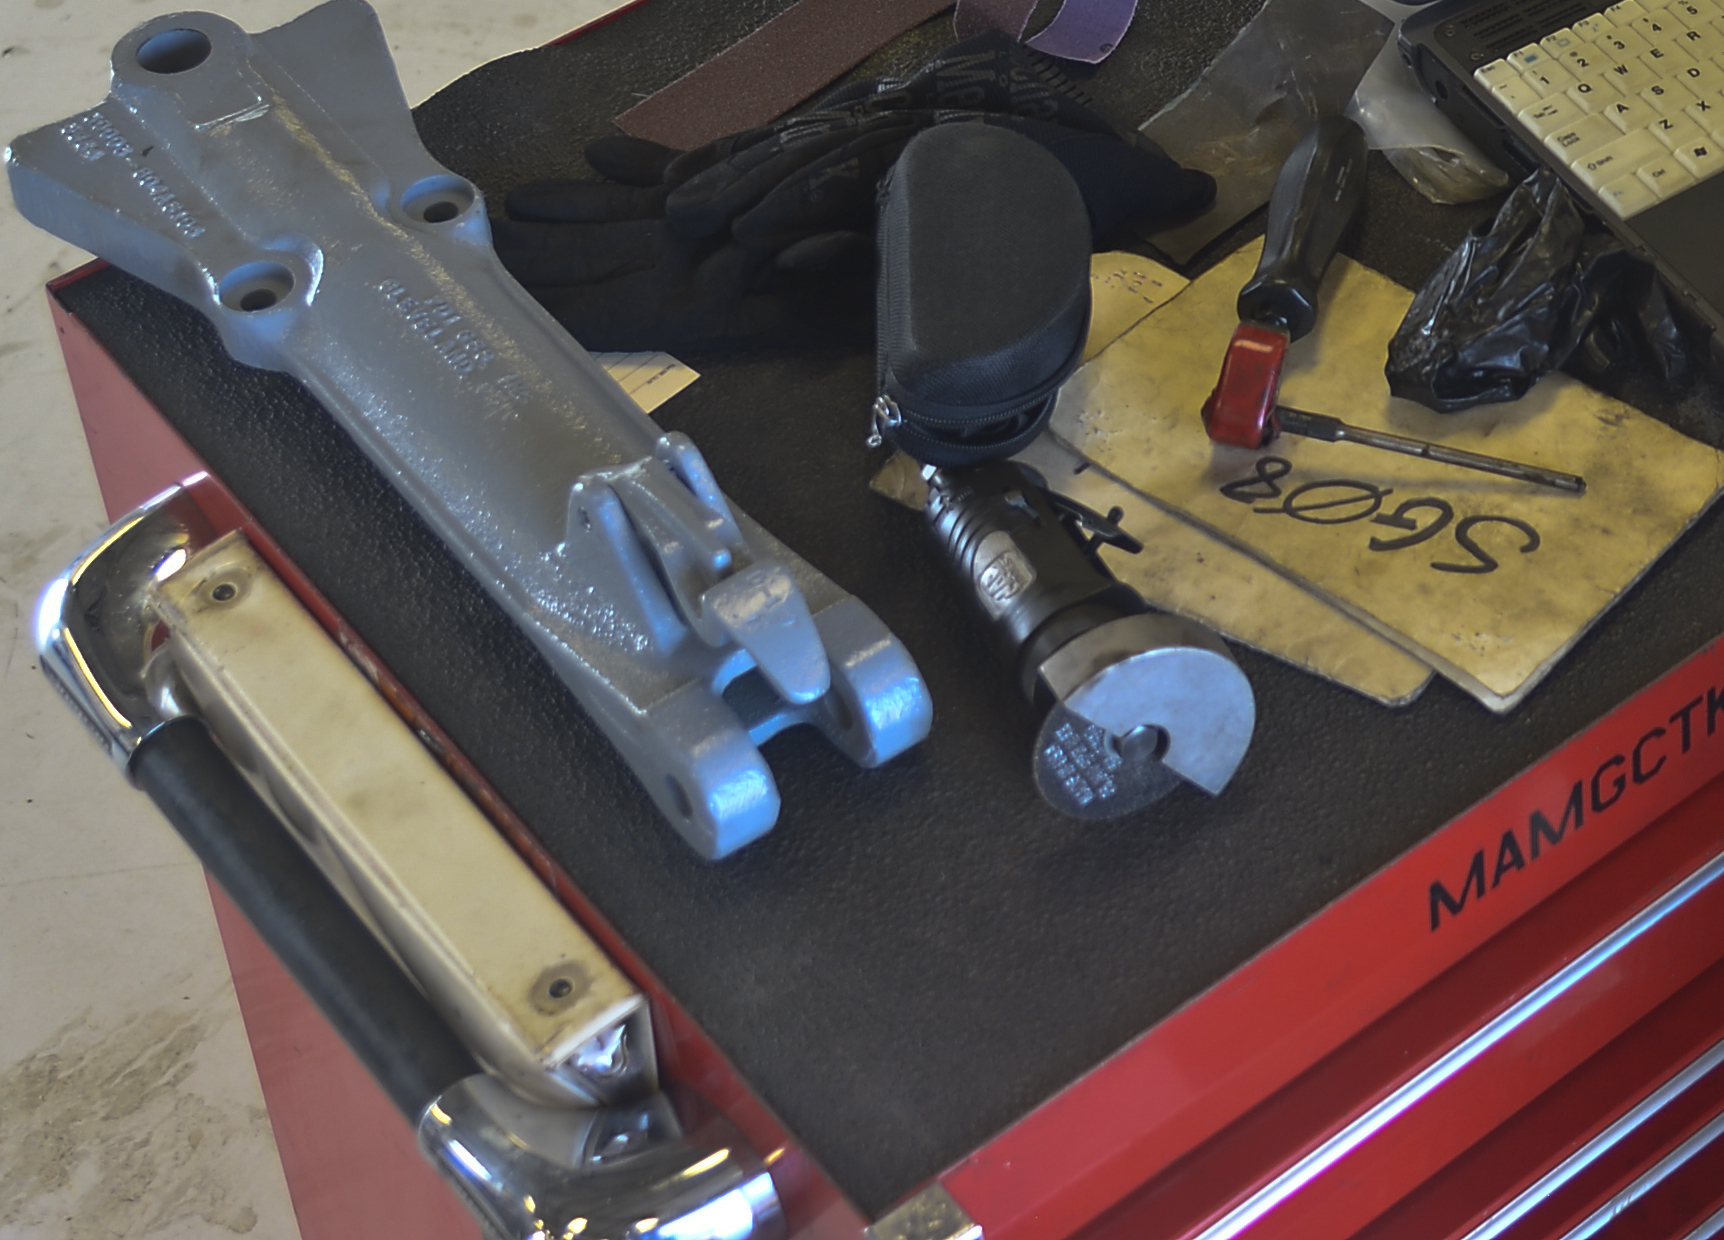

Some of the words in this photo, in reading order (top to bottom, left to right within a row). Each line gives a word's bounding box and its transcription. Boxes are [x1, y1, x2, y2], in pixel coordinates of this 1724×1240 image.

[1686, 6, 1698, 15] 5
[1652, 23, 1662, 31] 4
[1686, 31, 1701, 41] R
[1613, 41, 1625, 50] 3
[1650, 48, 1664, 58] E
[1576, 58, 1589, 68] 2
[1613, 64, 1628, 75] W
[1687, 68, 1700, 78] D
[1540, 76, 1550, 84] 1
[1577, 83, 1592, 93] Q
[1651, 85, 1664, 95] S
[1616, 104, 1629, 113] A
[1696, 100, 1711, 112] X
[1659, 119, 1673, 130] Z
